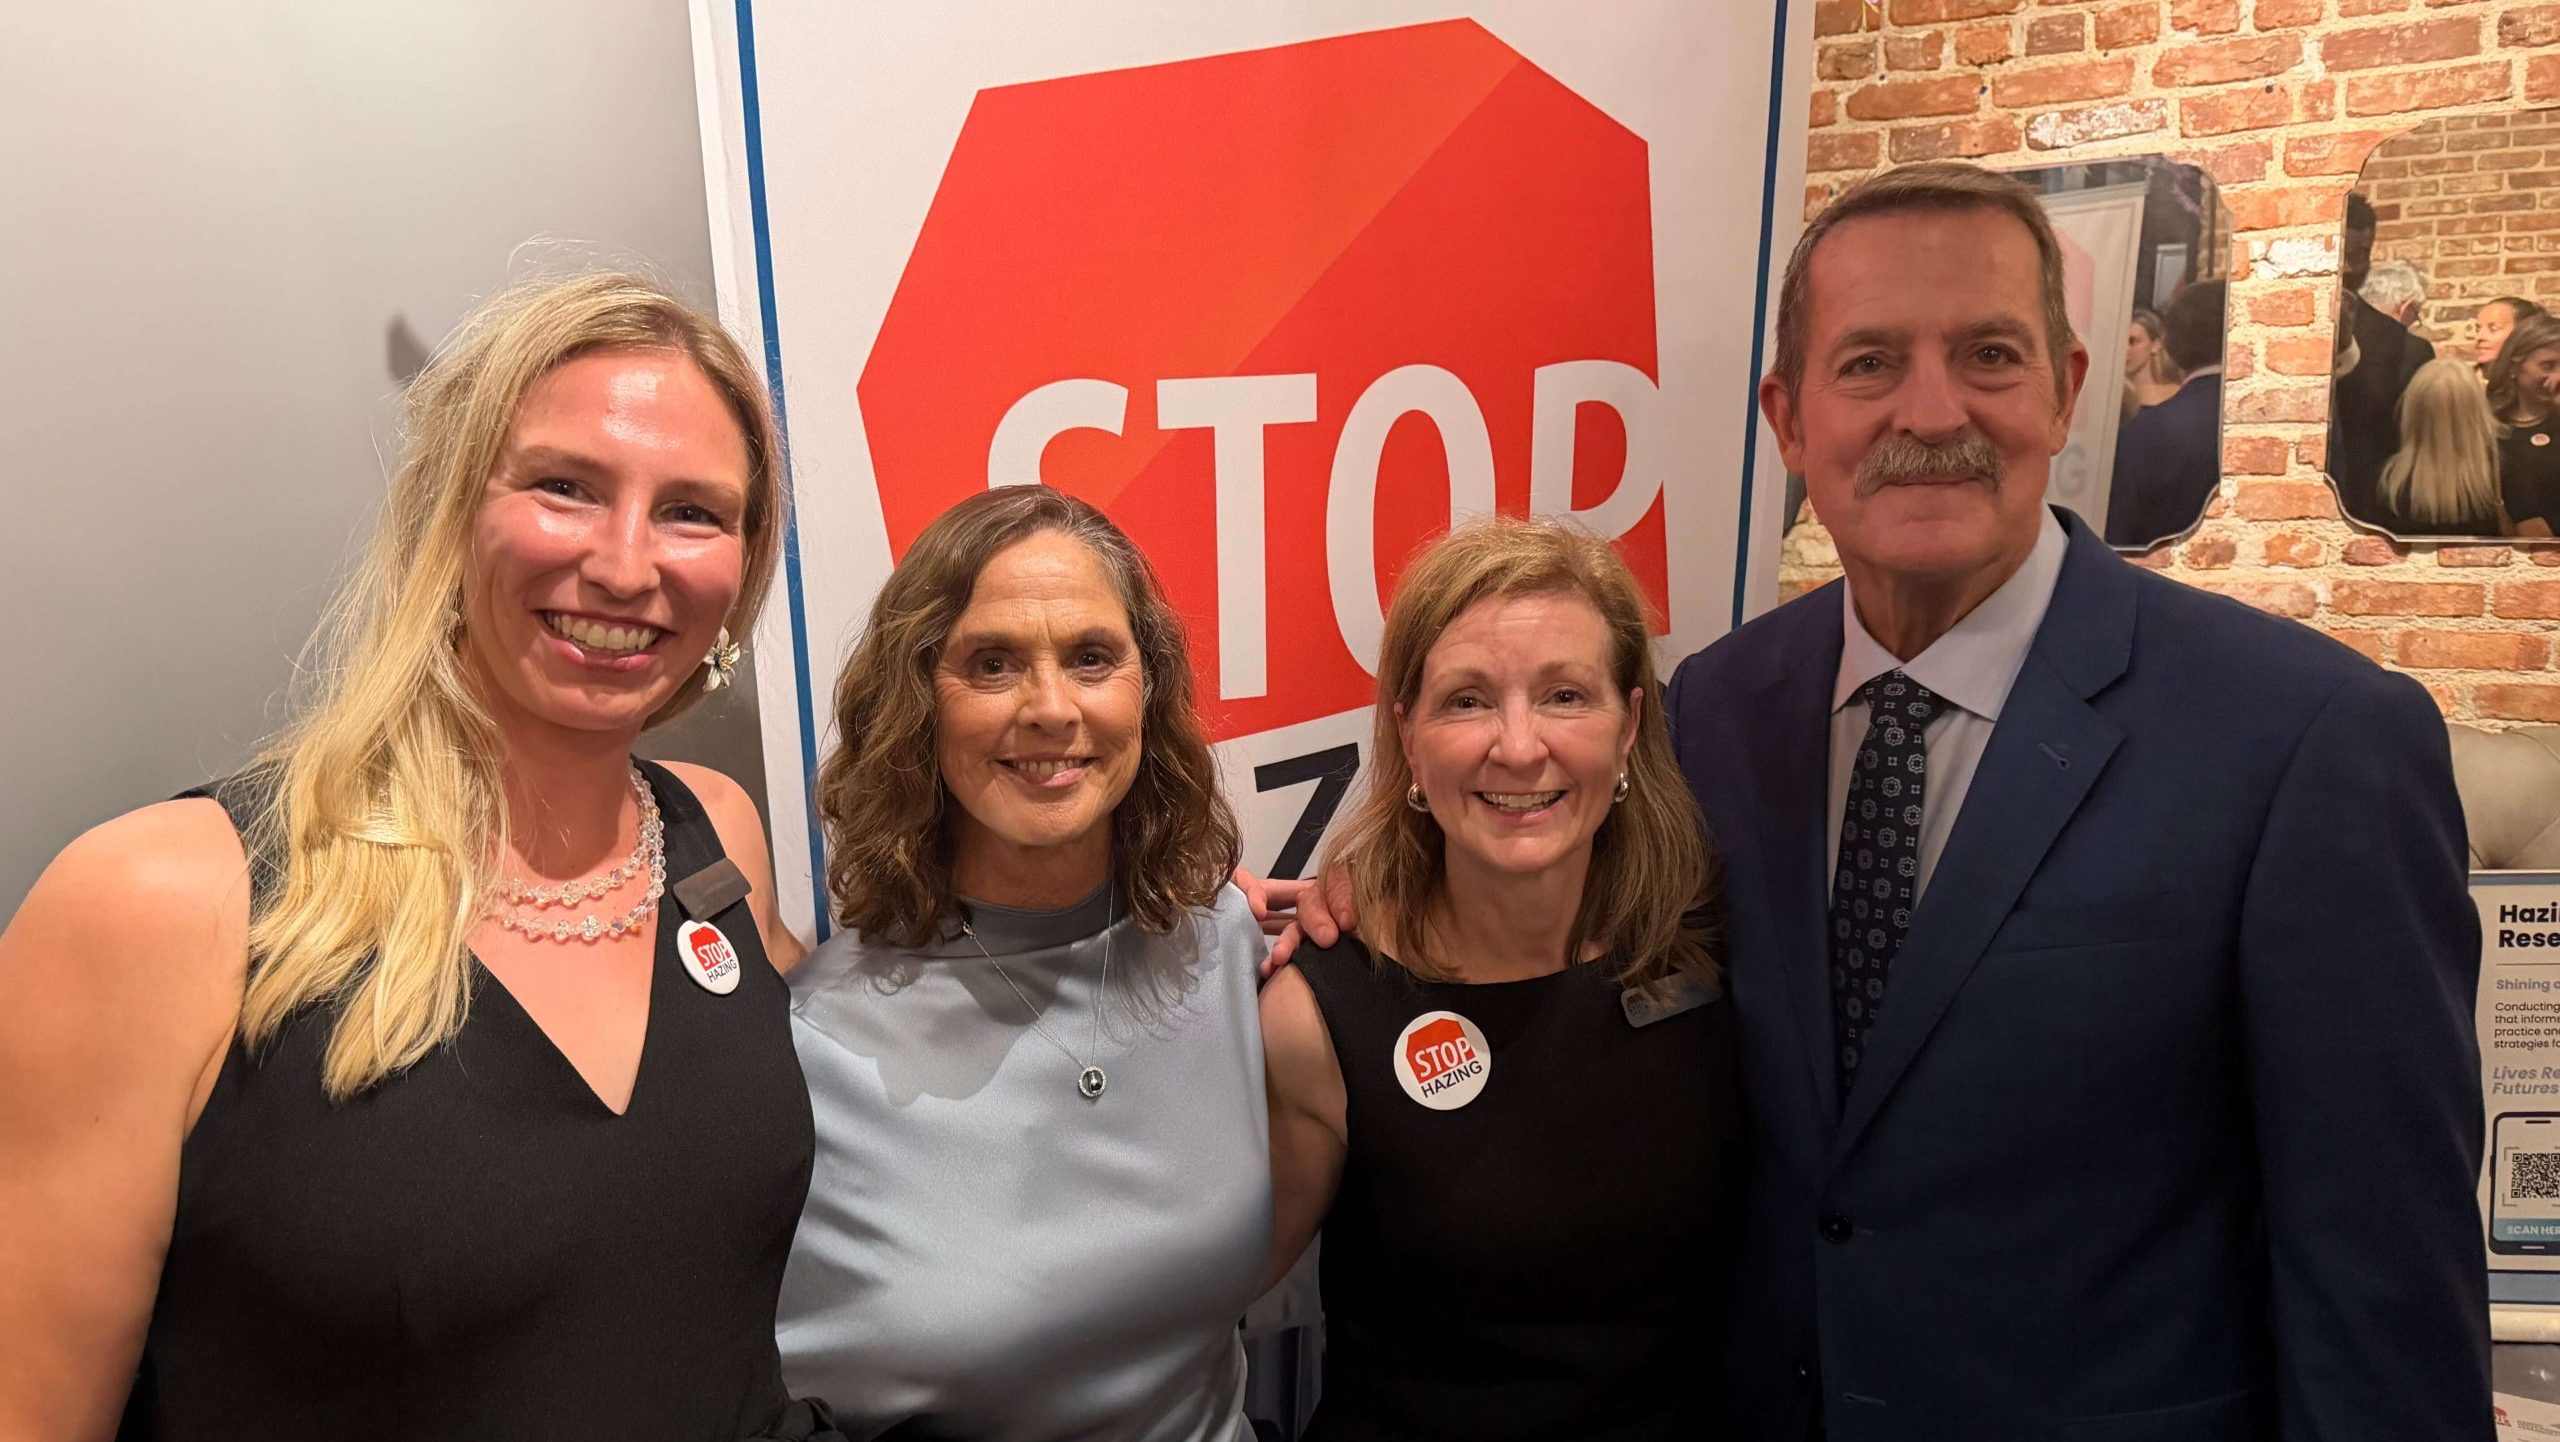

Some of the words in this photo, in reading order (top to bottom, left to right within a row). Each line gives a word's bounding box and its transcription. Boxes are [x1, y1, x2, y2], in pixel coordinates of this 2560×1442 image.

[2500, 901, 2560, 923] Hazi
[697, 941, 728, 967] STOP
[706, 958, 738, 983] HAZING
[2496, 978, 2551, 993] Shining
[2495, 1001, 2560, 1013] Conducting
[2495, 1015, 2518, 1024] that
[2495, 1026, 2541, 1039] practice
[2494, 1039, 2549, 1051] strategies
[1415, 1037, 1471, 1078] STOP
[1421, 1060, 1483, 1099] HAZING
[2493, 1065, 2537, 1080] Lives
[2492, 1082, 2559, 1095] Futures
[2506, 1224, 2539, 1236] SCAN
